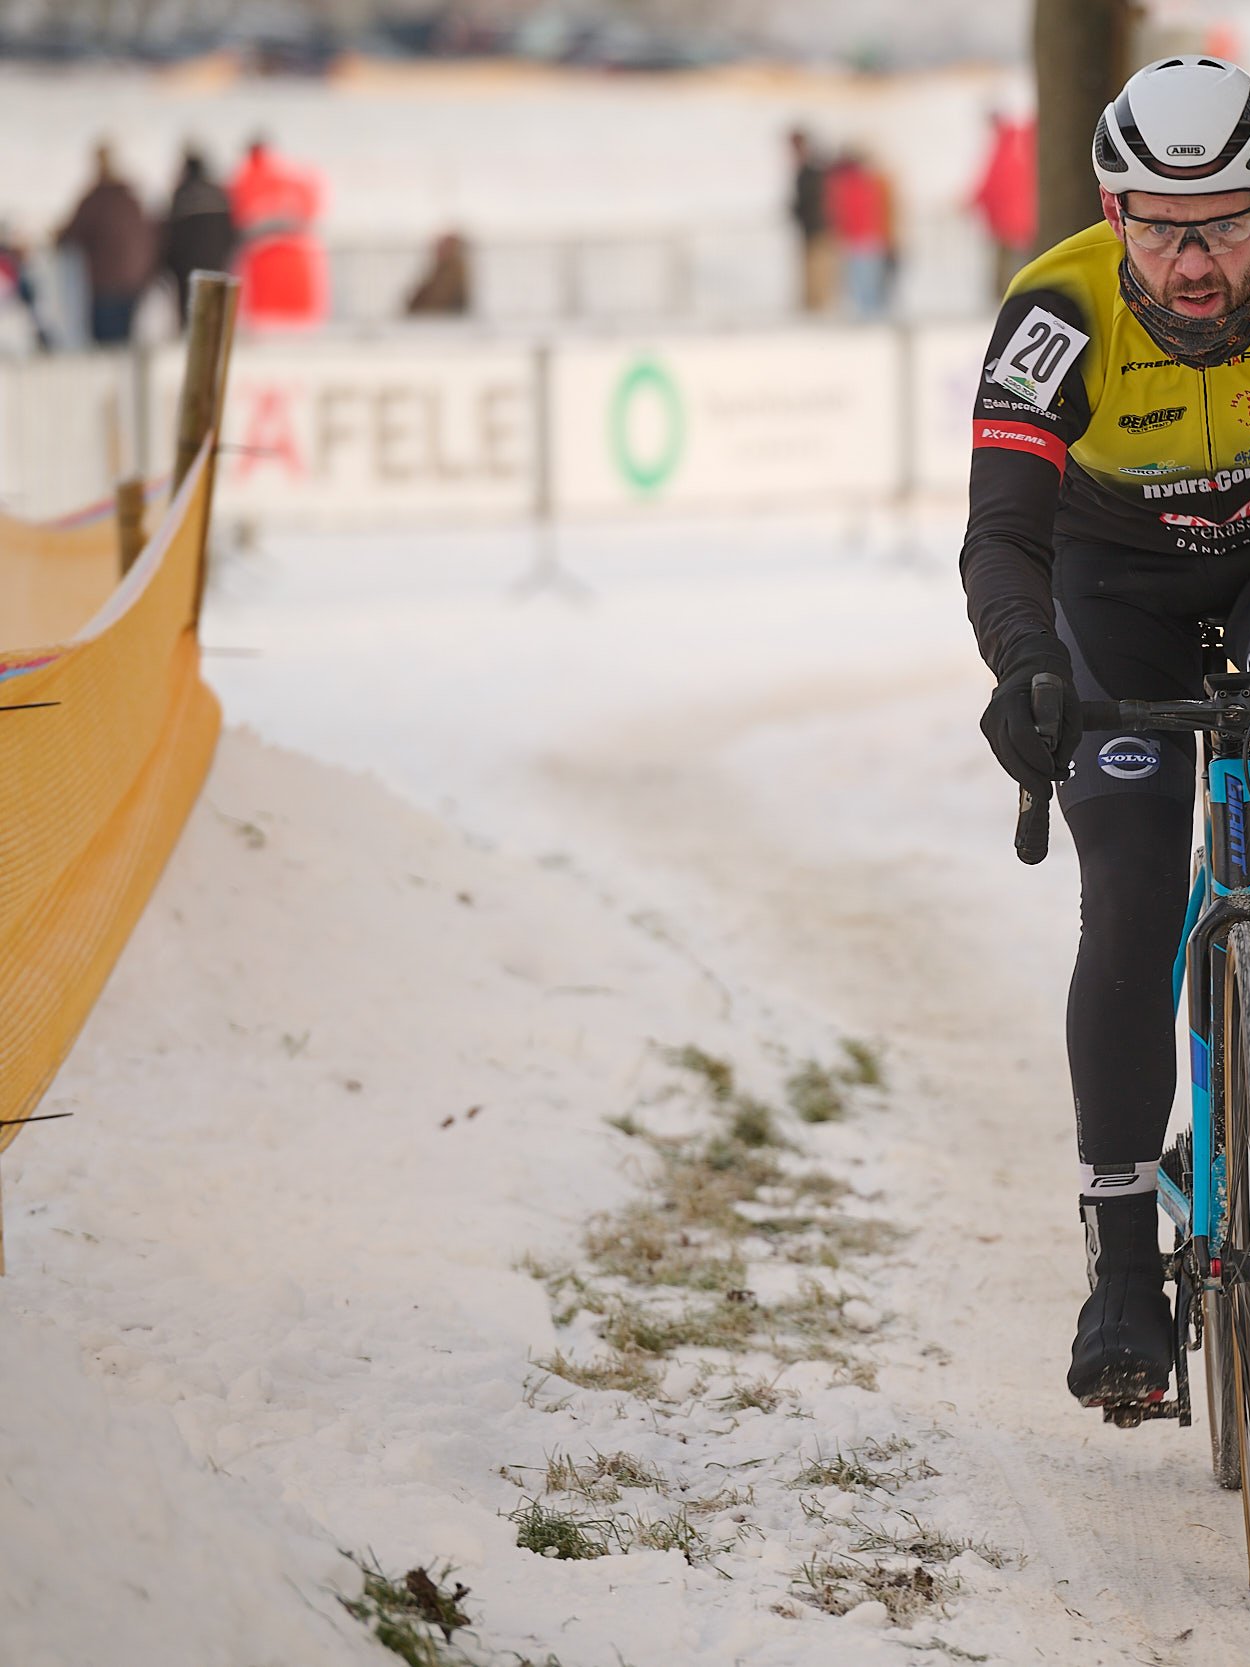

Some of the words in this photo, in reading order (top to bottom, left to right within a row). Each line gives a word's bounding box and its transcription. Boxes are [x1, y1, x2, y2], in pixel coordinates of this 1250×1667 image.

[1010, 322, 1071, 383] 20
[1101, 754, 1157, 764] VOLVO
[1226, 775, 1247, 877] GIANT
